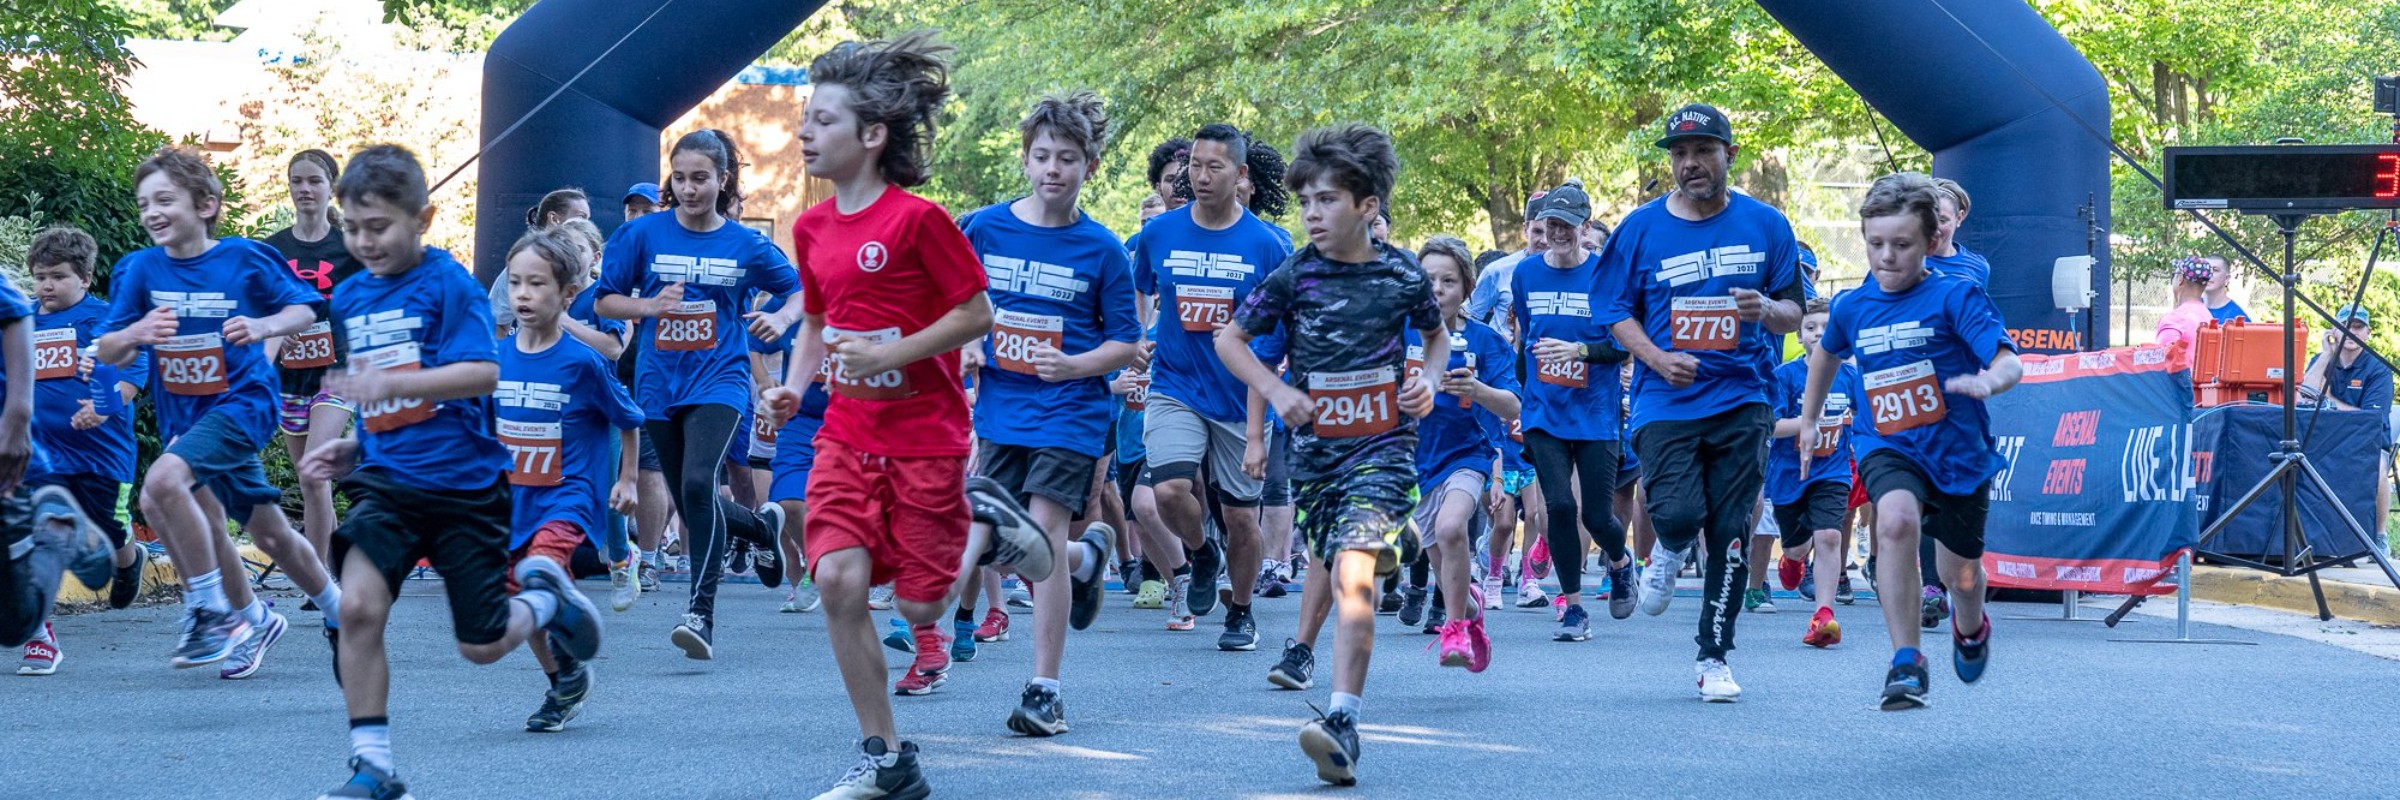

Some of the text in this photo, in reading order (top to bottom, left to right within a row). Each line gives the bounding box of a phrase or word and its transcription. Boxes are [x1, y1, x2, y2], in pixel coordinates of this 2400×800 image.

[1682, 111, 1711, 126] NATIVE
[2376, 154, 2400, 197] 3
[1051, 289, 1071, 299] 2022
[1179, 301, 1229, 323] 2775
[658, 318, 713, 341] 2883
[1675, 315, 1736, 340] 2779
[2010, 329, 2085, 350] RSENAL
[35, 346, 73, 370] 823
[159, 355, 223, 384] 2932
[1540, 359, 1585, 380] 2842
[1316, 391, 1389, 426] 2941
[1872, 384, 1940, 424] 2913
[2051, 409, 2102, 448] ARSENAL
[503, 444, 557, 474] 777
[2042, 458, 2087, 495] EVENTS
